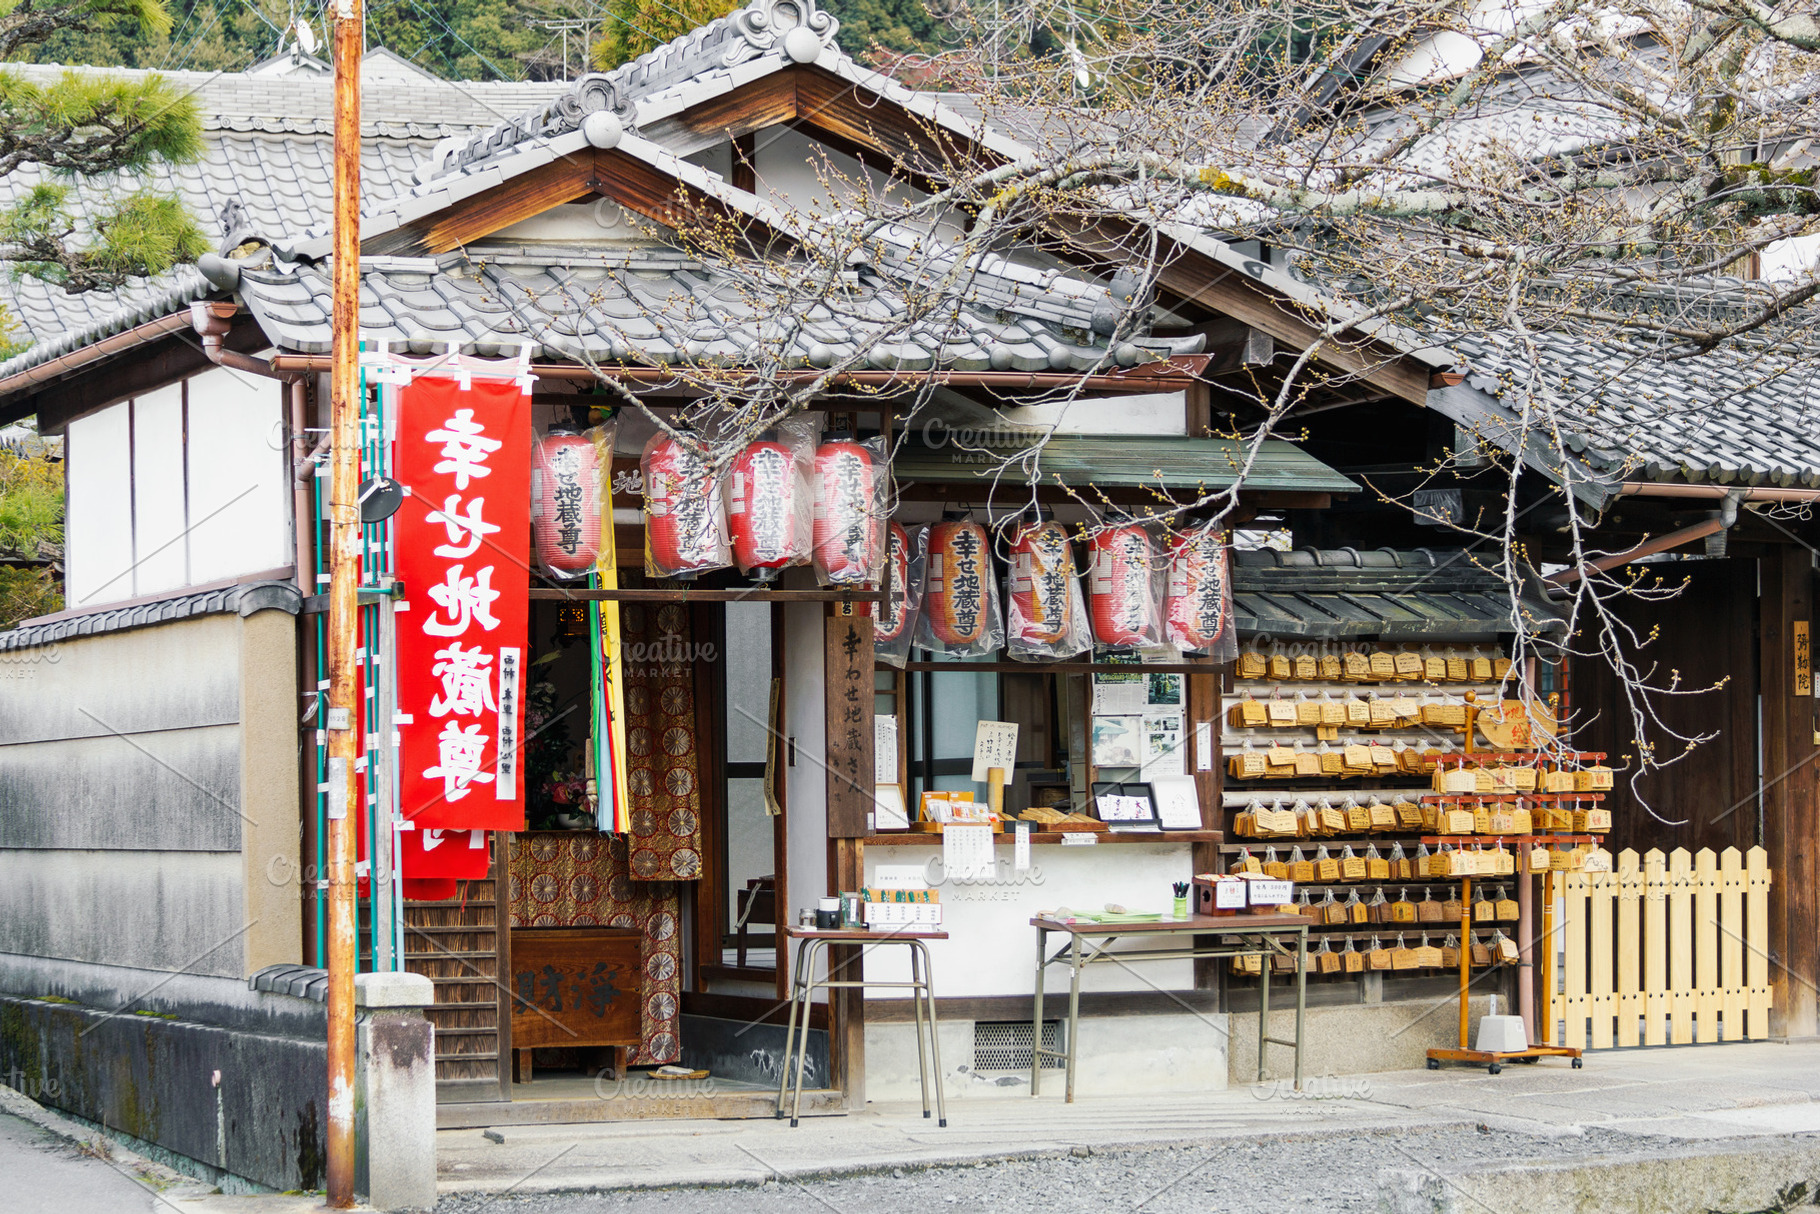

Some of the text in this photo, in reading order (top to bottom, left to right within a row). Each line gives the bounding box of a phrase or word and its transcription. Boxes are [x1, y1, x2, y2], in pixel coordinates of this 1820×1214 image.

[553, 447, 584, 555] 幸せ地蔵尊
[952, 530, 981, 636] 幸せ地蔵尊
[1197, 536, 1223, 639] 幸せ地蔵尊
[841, 624, 863, 794] 幸わせ地蔵さん
